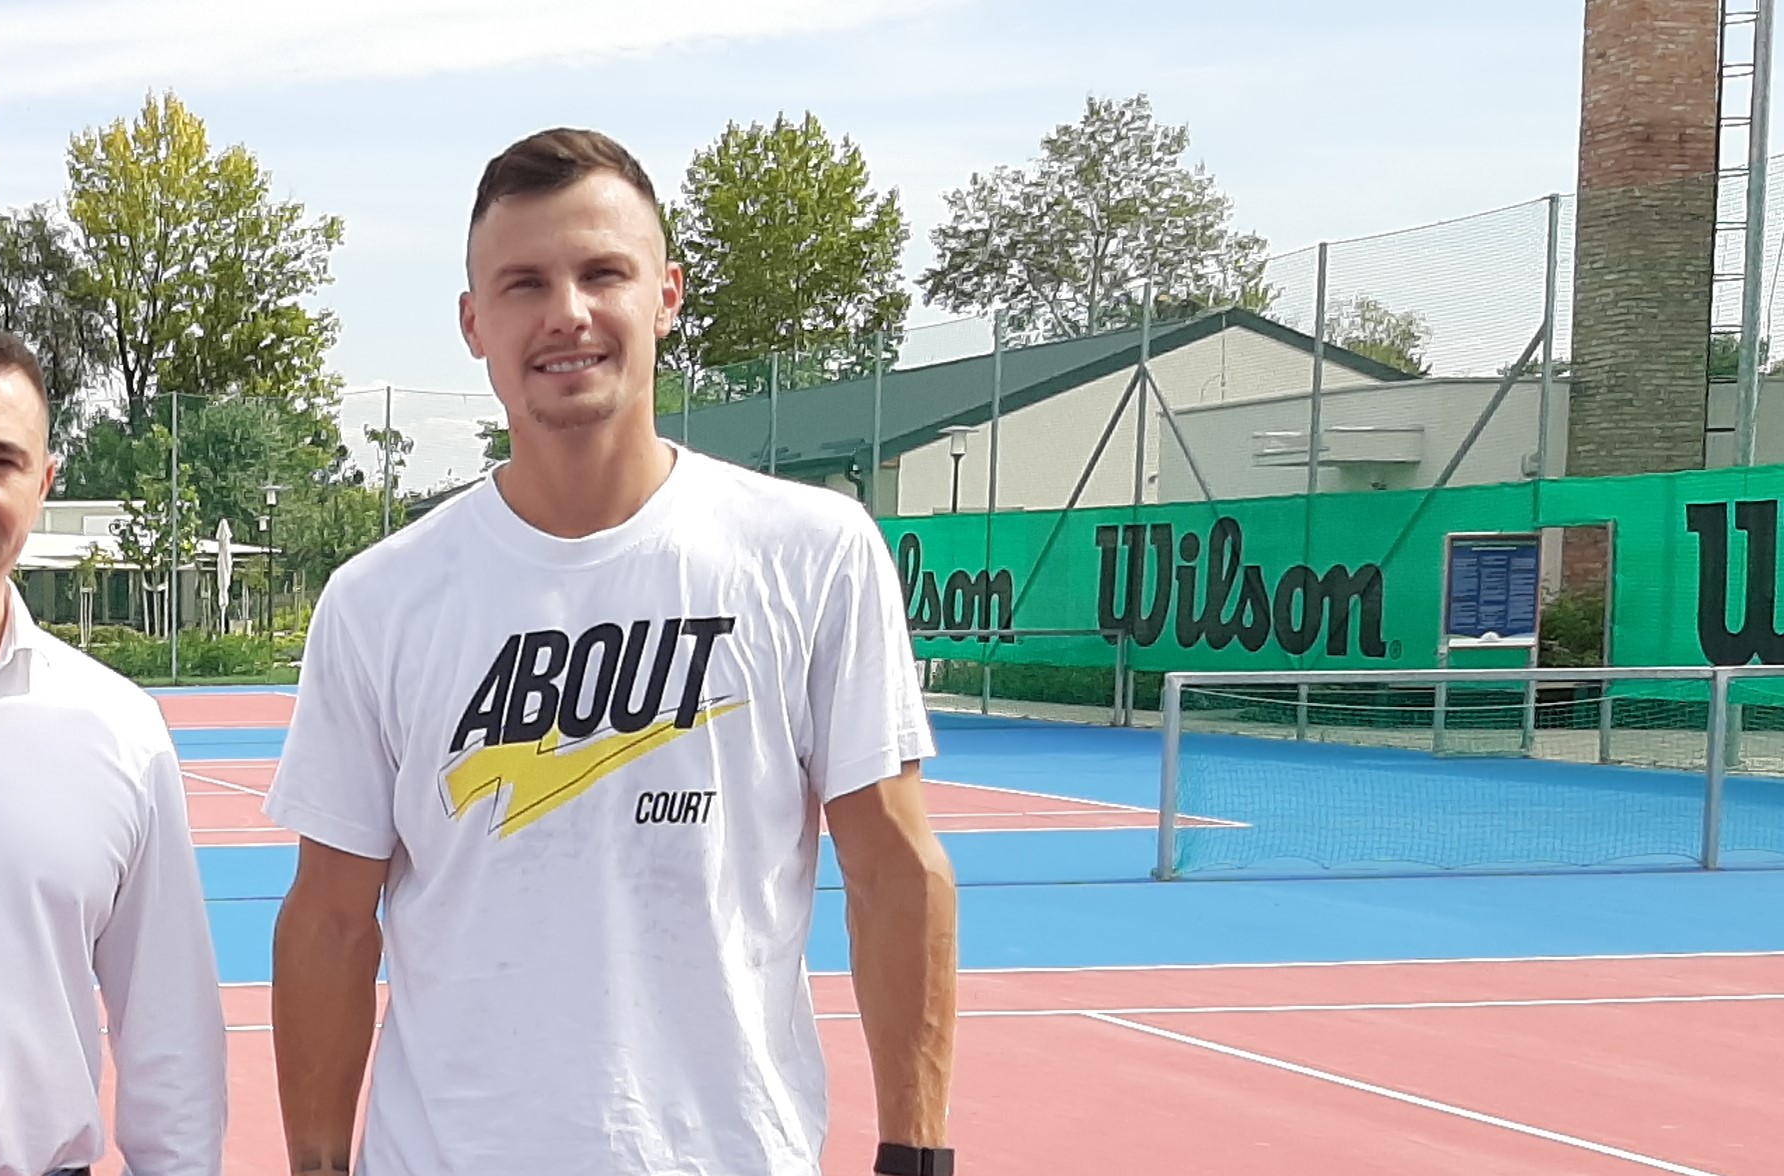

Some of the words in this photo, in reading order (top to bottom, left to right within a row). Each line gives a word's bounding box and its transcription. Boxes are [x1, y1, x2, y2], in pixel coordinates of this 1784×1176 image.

[898, 532, 1015, 644] lson
[1095, 516, 1387, 658] Wilson
[448, 616, 735, 754] ABOUT
[635, 790, 717, 825] COURT
